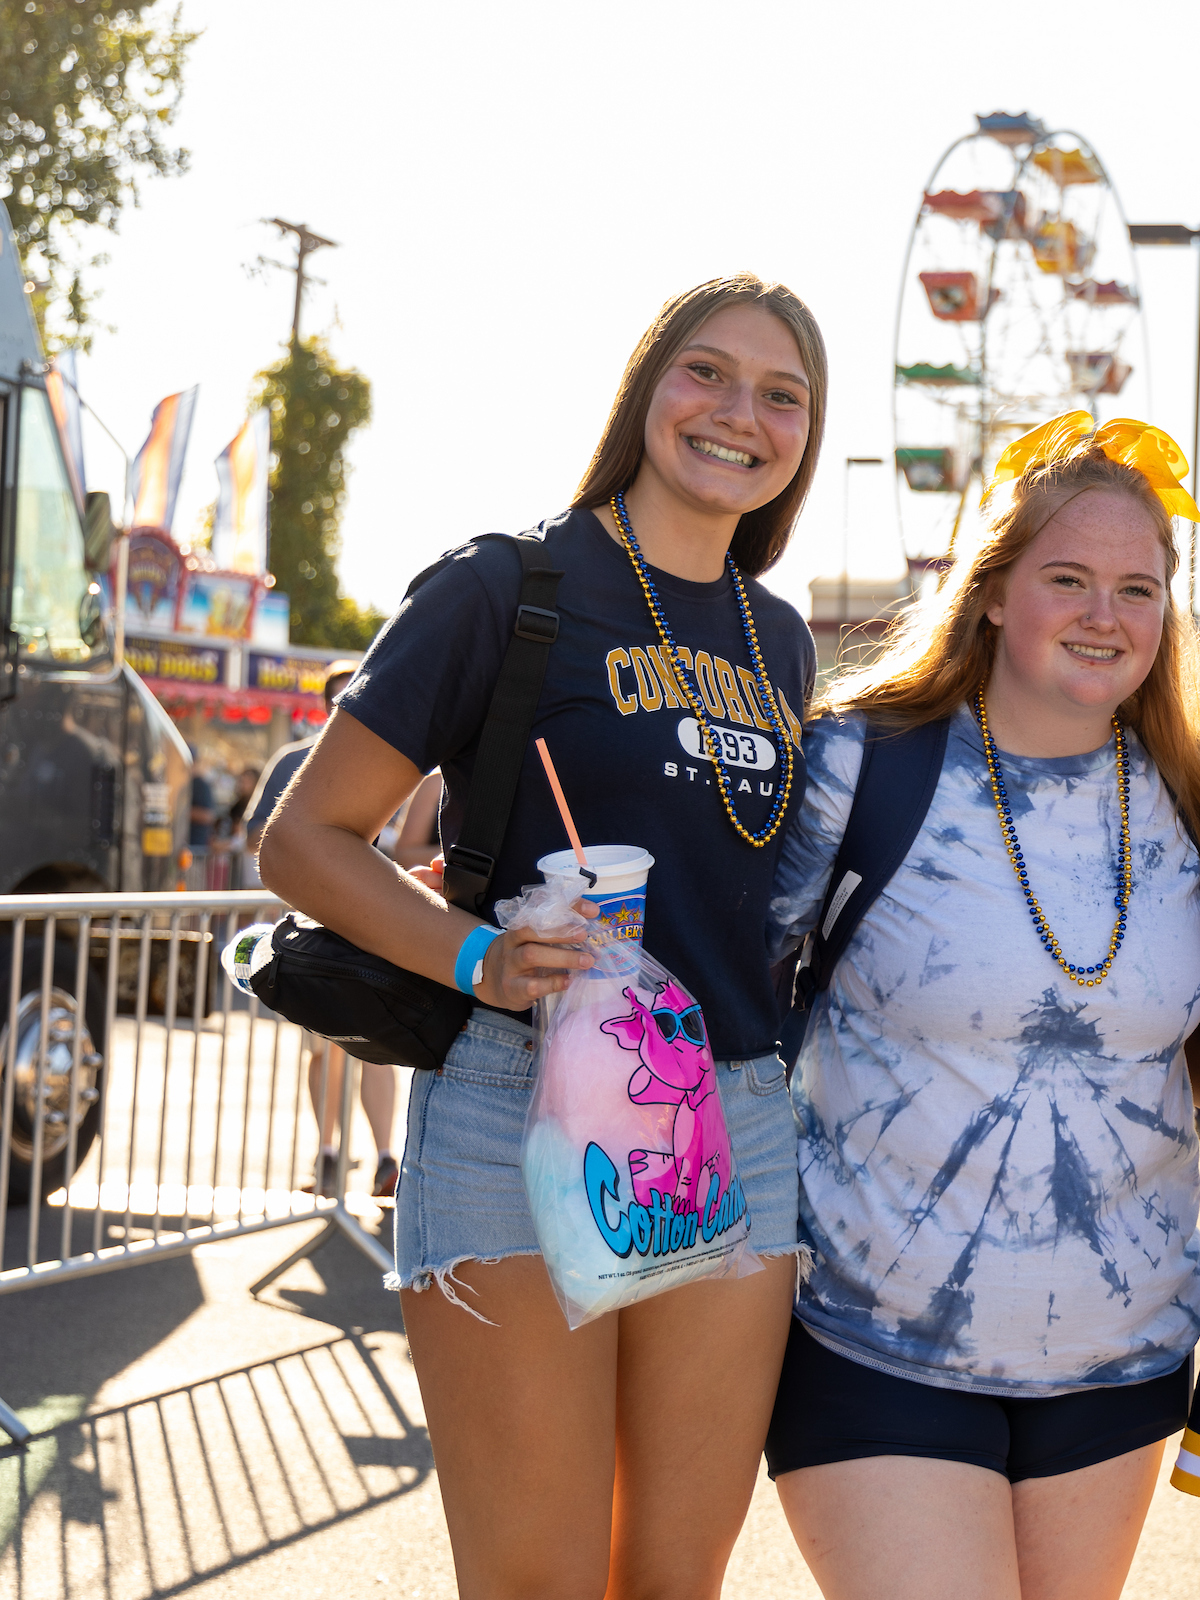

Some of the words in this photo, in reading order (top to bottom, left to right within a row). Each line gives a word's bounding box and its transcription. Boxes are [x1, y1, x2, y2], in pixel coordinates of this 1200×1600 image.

[606, 645, 805, 759] CONORDA
[663, 761, 711, 785] ST.
[719, 775, 784, 797] AU
[584, 1141, 699, 1260] Cotton
[702, 1172, 752, 1244] Can
